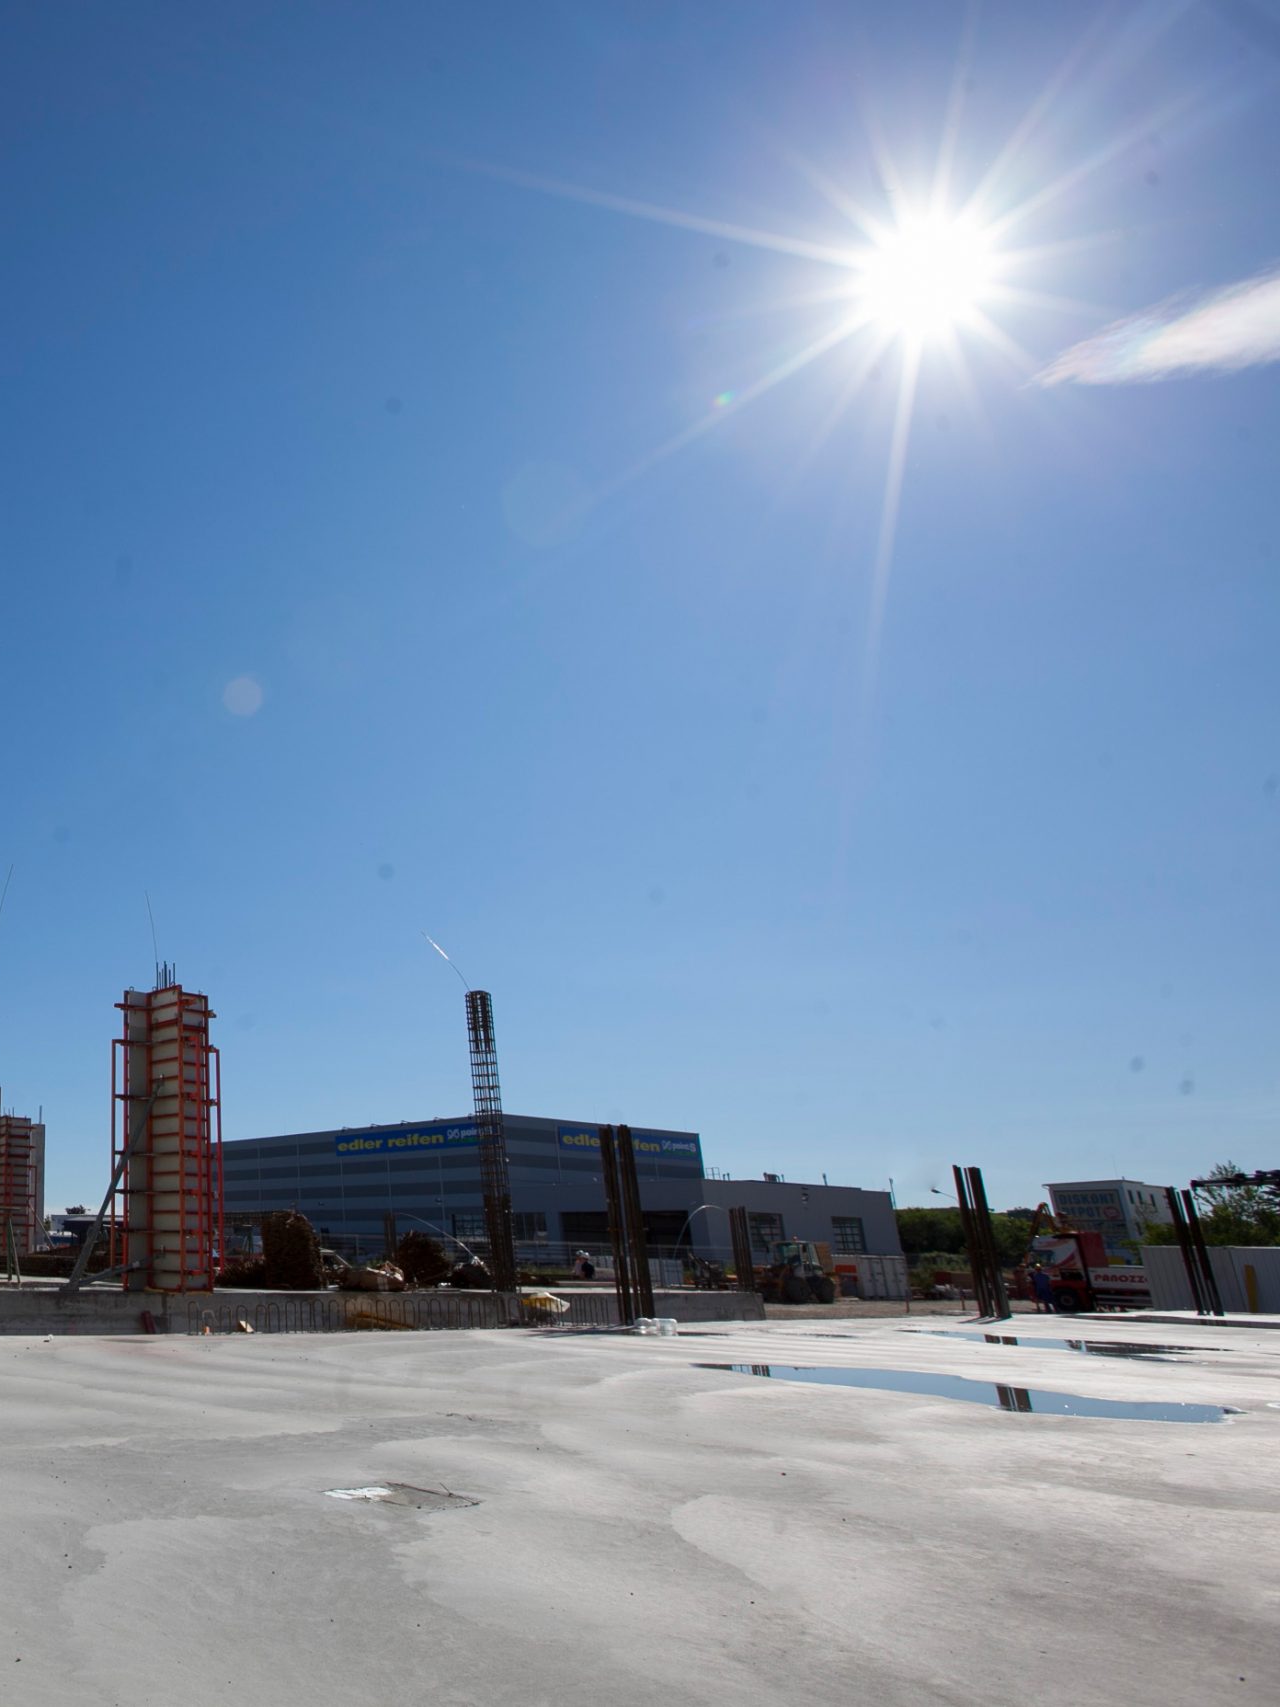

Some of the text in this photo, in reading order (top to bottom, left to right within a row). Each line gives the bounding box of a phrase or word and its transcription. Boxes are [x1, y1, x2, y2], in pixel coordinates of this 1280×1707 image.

[337, 1138, 383, 1152] edler
[387, 1134, 445, 1147] reifen
[562, 1134, 601, 1147] edle
[1058, 1193, 1115, 1205] DISKONT
[1094, 1274, 1149, 1283] PANOZZ
